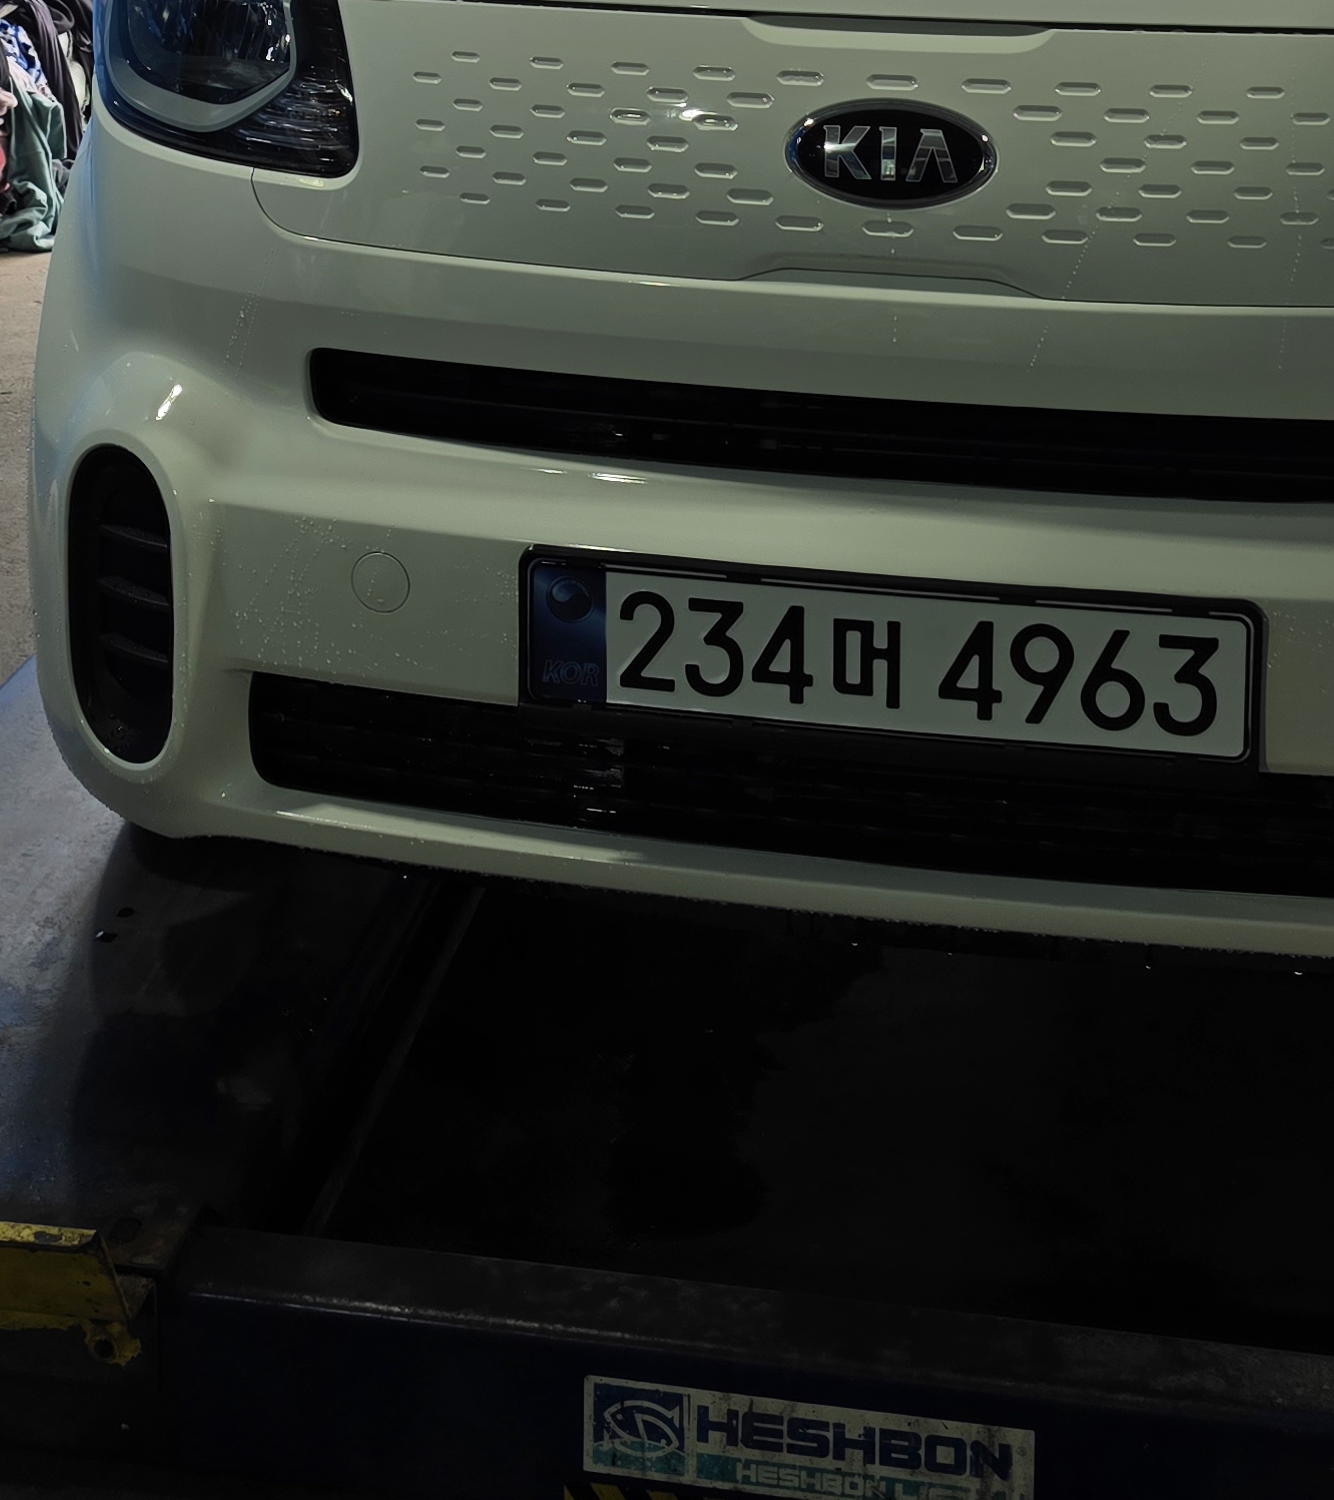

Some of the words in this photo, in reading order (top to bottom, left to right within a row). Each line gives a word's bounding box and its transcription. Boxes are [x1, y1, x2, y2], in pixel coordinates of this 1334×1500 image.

[822, 124, 959, 184] KIA
[542, 658, 600, 688] KOR
[618, 590, 902, 711] 234머
[938, 620, 1220, 738] 4963
[695, 1404, 1013, 1482] HESHBON
